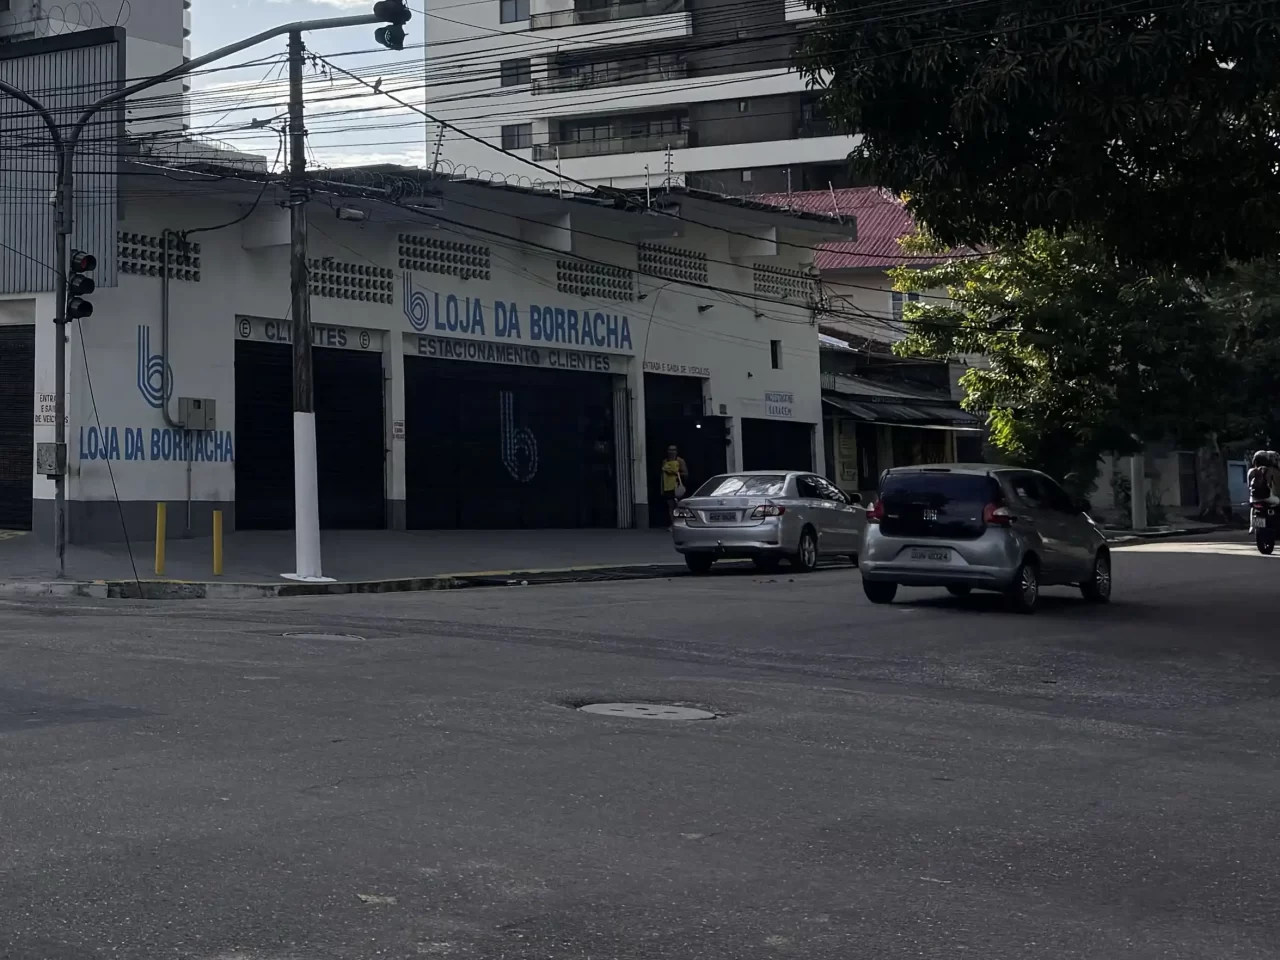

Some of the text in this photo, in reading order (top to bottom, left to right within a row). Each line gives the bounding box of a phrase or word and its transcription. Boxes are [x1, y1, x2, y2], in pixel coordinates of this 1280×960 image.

[265, 323, 347, 347] CLITES
[434, 293, 633, 350] LOJA DA BORRACHA
[418, 338, 610, 371] ESTACIONAMENTO CLIENTES
[80, 426, 235, 462] LOJA DA BORRACHA
